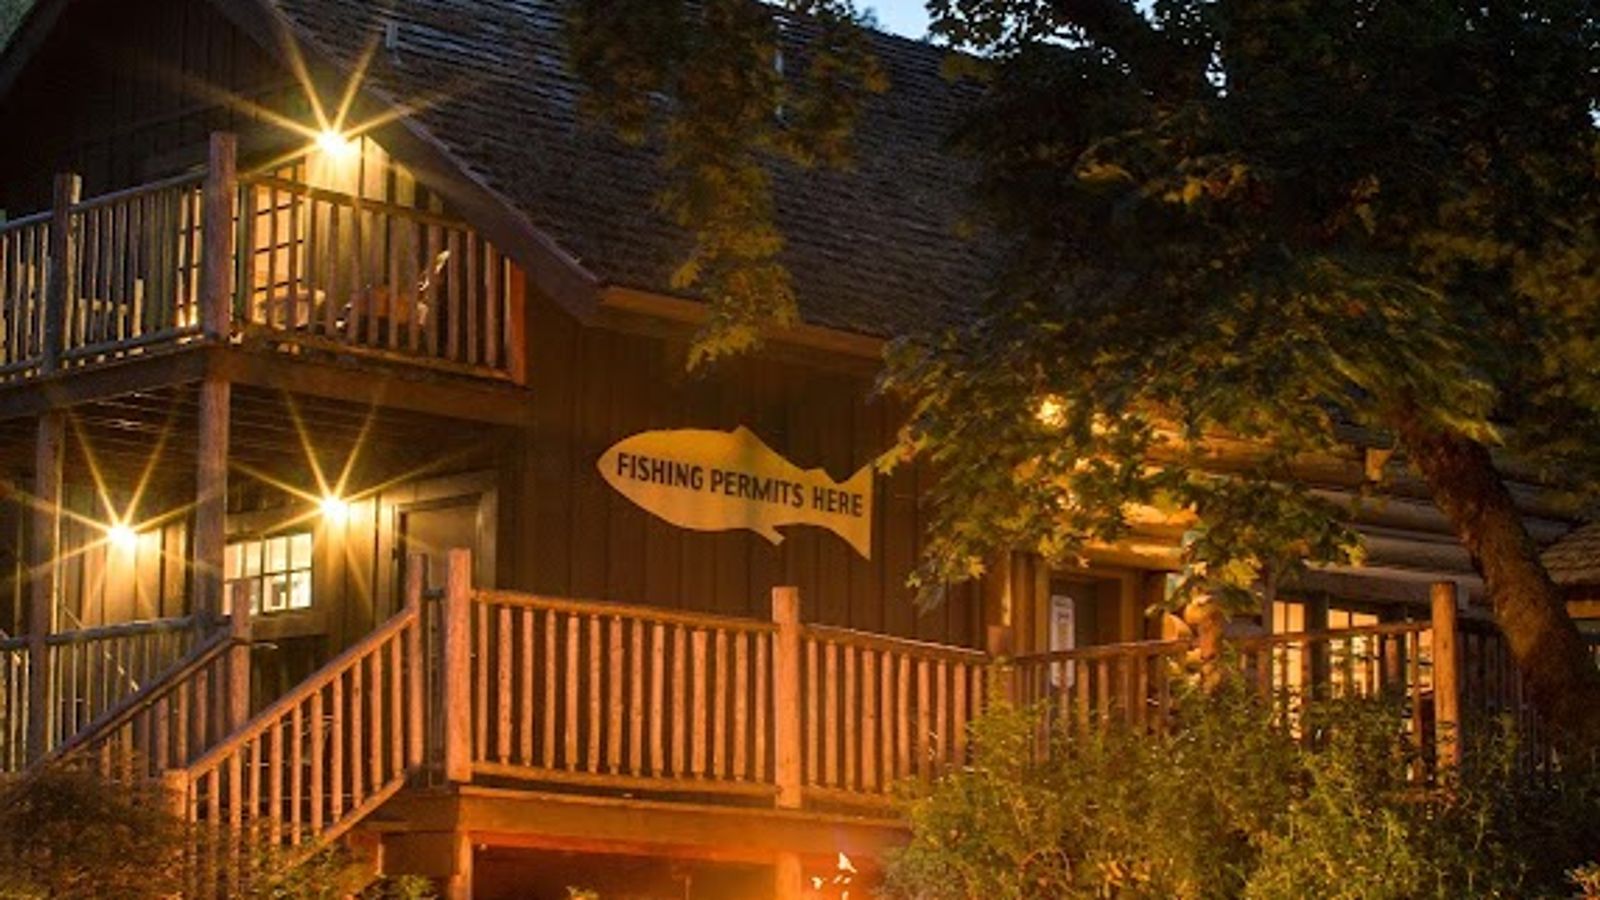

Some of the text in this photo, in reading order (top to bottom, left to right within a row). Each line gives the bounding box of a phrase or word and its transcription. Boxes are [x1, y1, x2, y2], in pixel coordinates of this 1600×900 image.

[617, 452, 863, 517] FISHING PERMITS HERE
